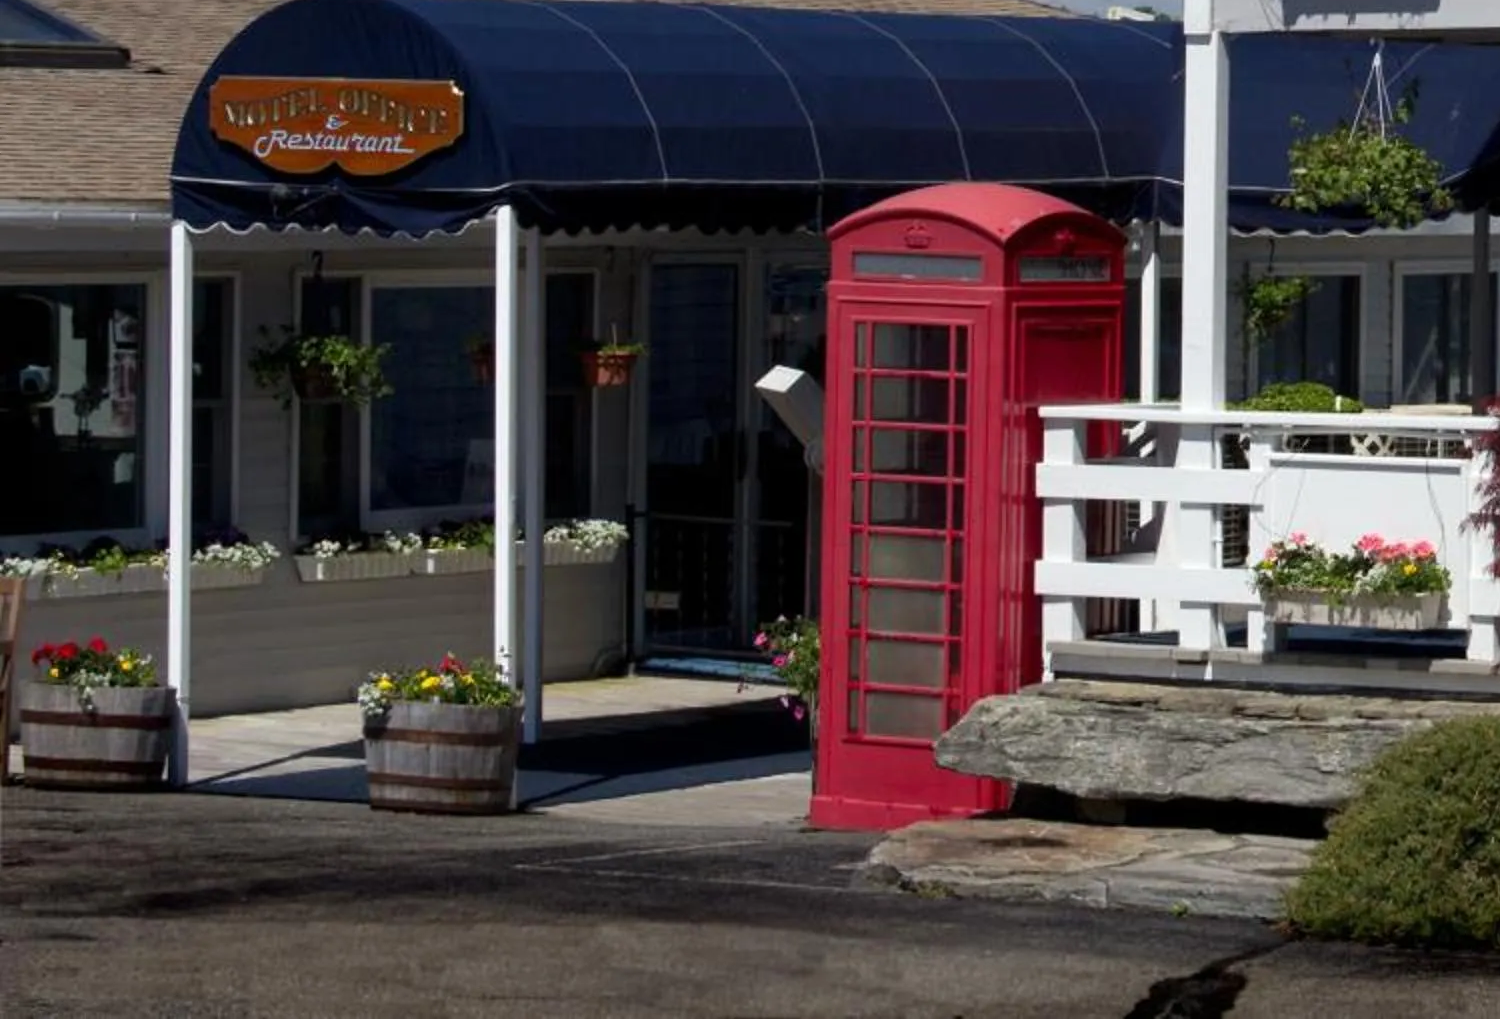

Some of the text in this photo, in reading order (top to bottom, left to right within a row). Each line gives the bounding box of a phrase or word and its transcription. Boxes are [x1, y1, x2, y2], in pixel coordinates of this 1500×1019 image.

[224, 87, 449, 134] MOTEL OFFICE
[325, 113, 349, 131] &
[253, 129, 415, 158] Restaurant
